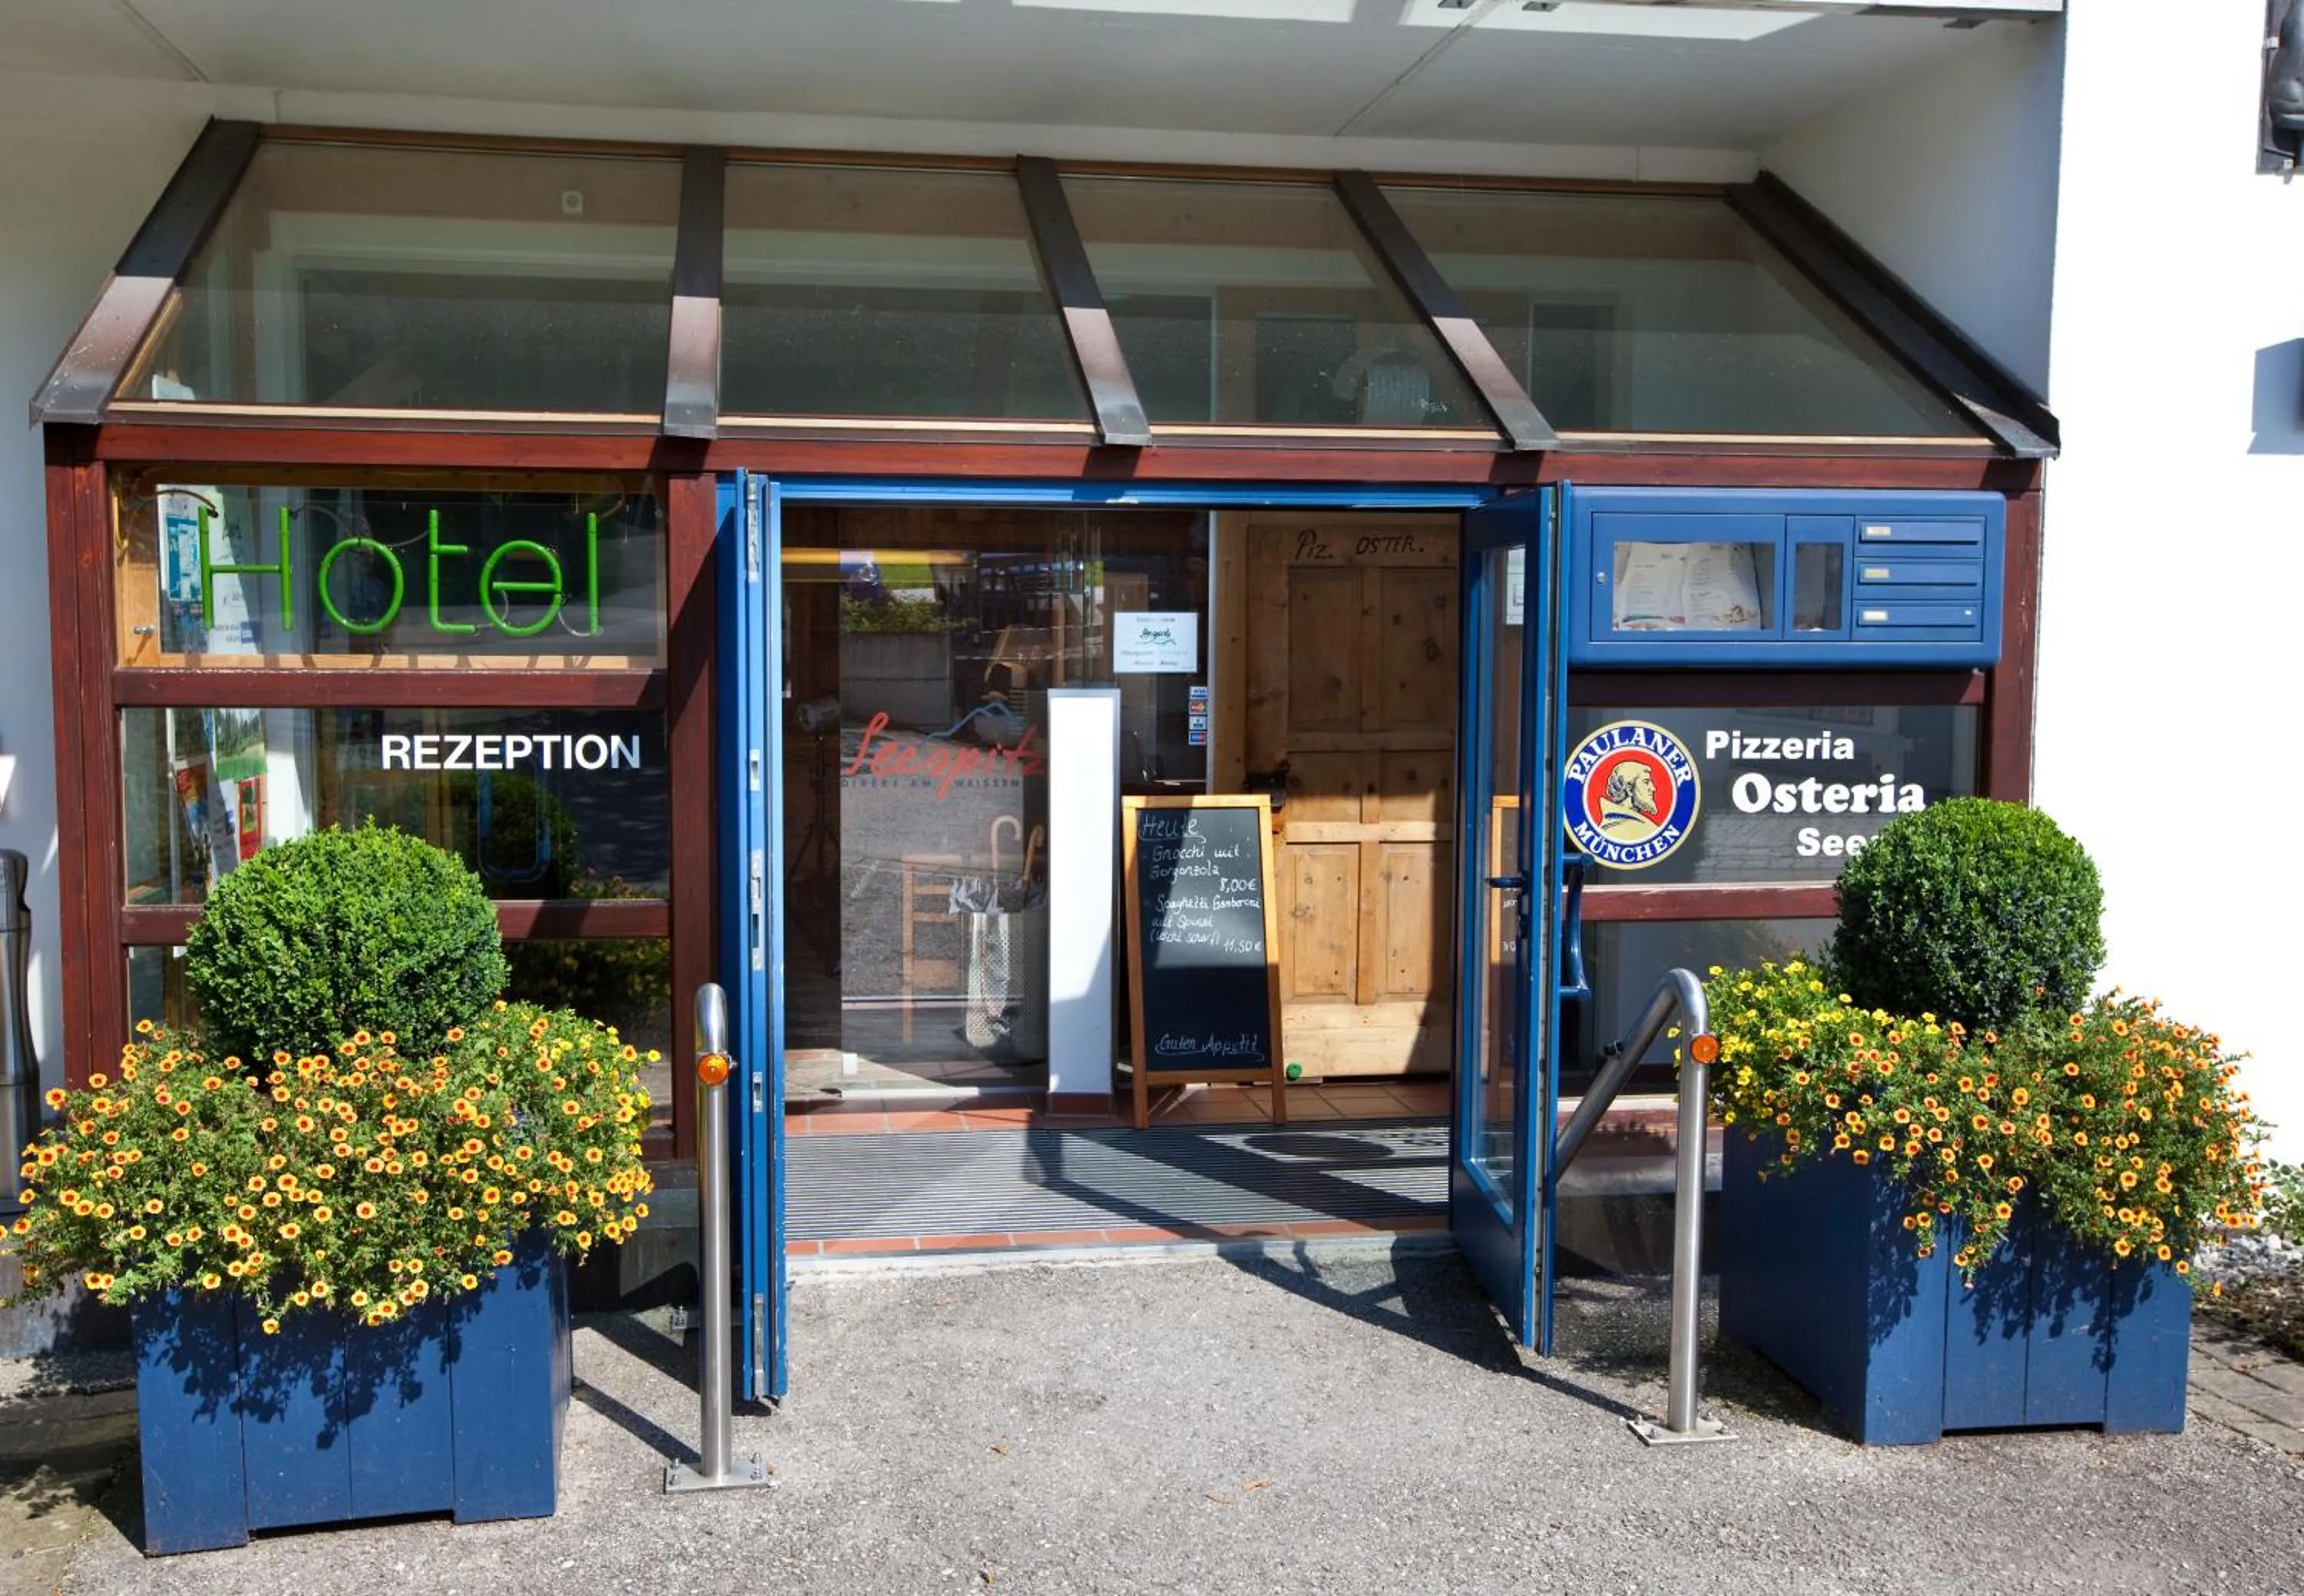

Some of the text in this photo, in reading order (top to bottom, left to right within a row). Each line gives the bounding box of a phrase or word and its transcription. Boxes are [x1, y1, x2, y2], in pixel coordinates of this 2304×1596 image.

[197, 506, 599, 636] Hotel
[382, 734, 641, 770] REZEPTION
[1567, 727, 1694, 786] PAULANER
[1706, 730, 1855, 760] Pizzeria
[1732, 772, 1926, 814] Osteria
[1142, 814, 1200, 836] Heute
[1152, 843, 1240, 861] Gnocchi mit
[1574, 820, 1682, 864] MÜNCHEN
[1796, 826, 1880, 857] See
[1150, 859, 1220, 883] Gorgonzola
[1158, 1033, 1197, 1051] Guten
